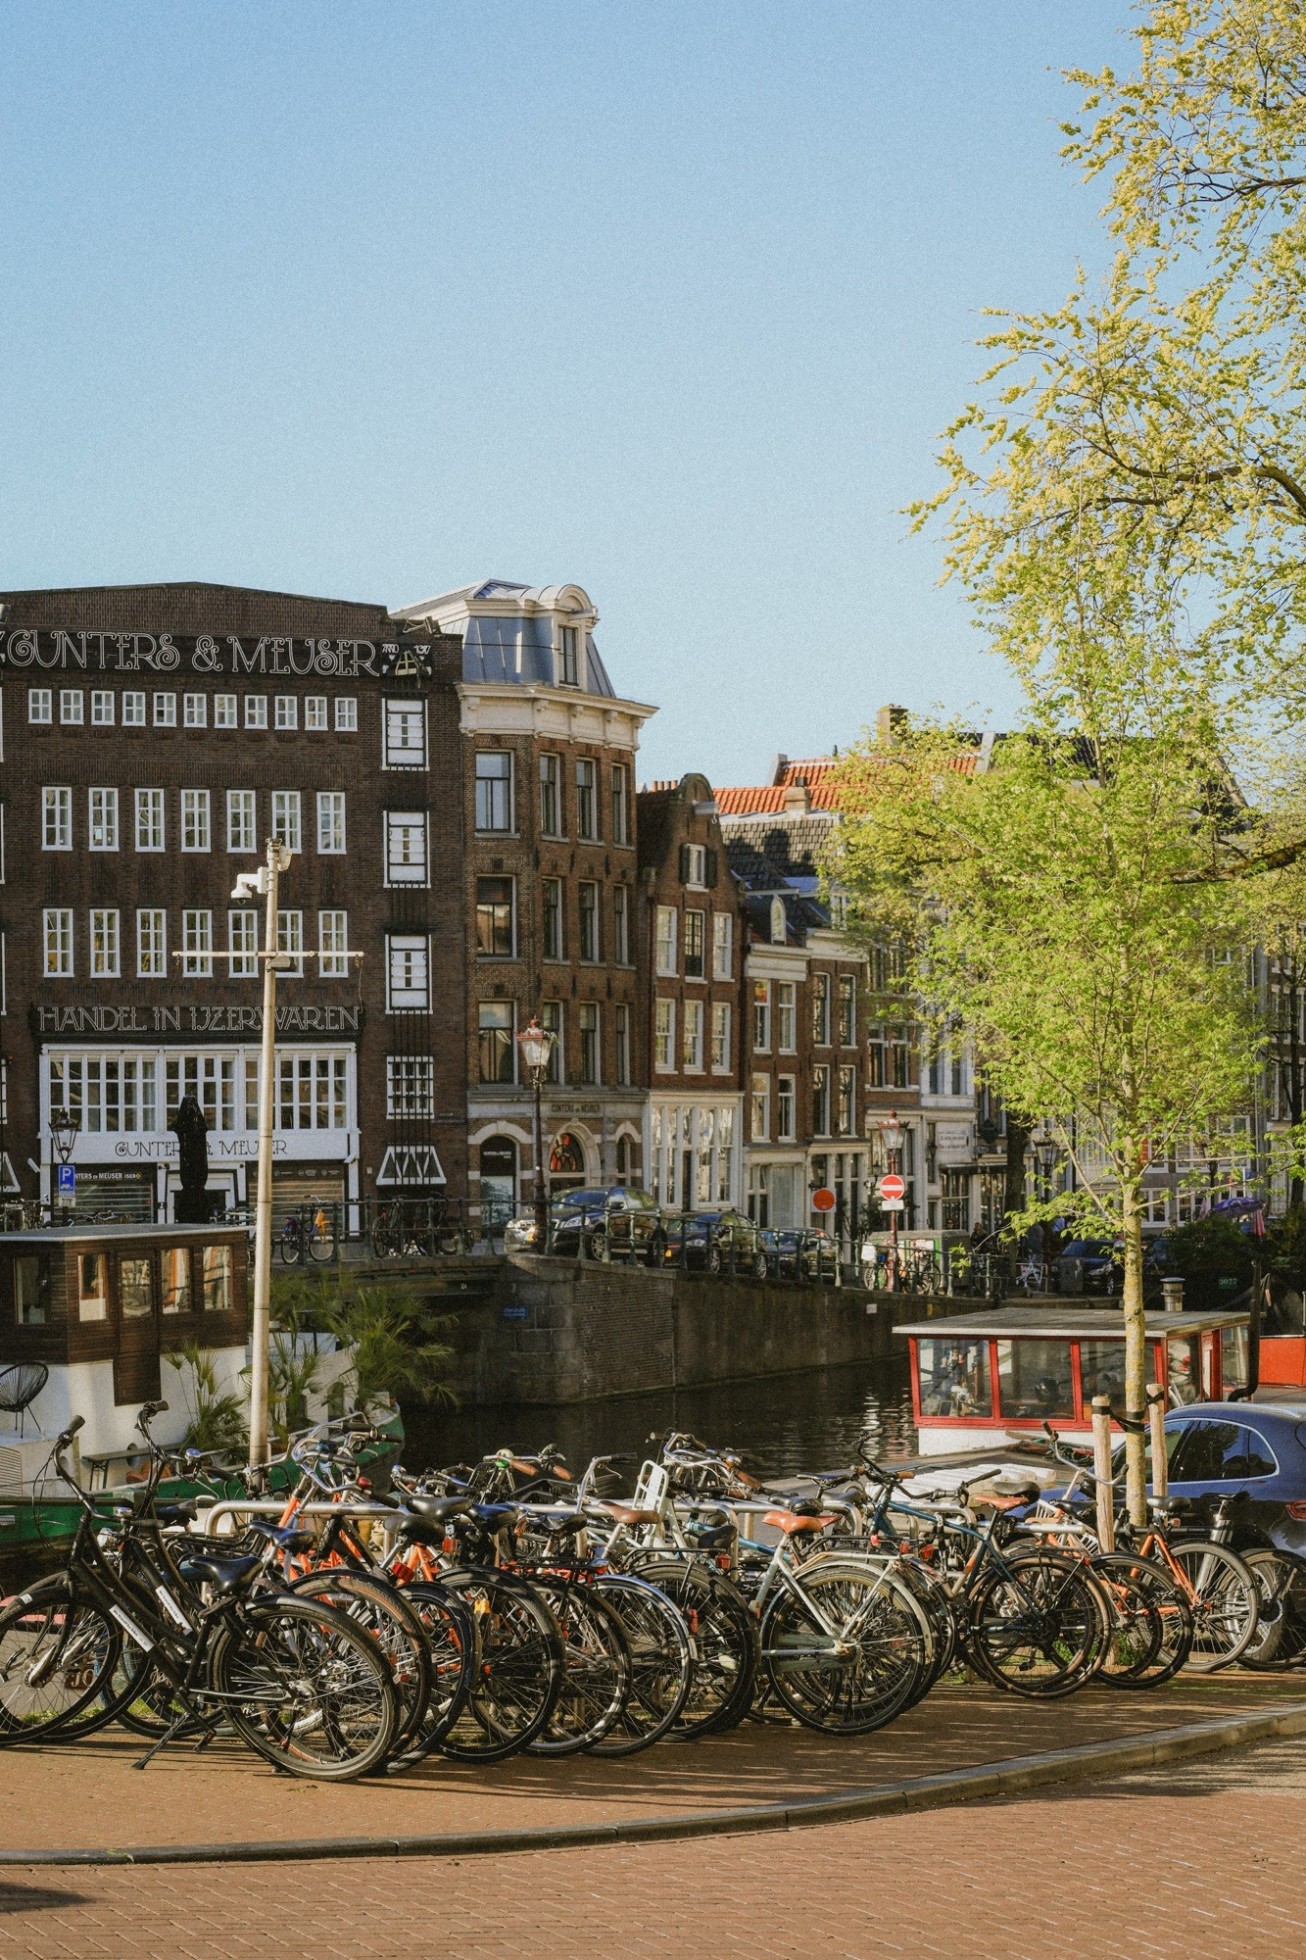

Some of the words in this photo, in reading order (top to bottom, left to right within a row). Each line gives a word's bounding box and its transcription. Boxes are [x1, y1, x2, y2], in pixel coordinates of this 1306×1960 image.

[7, 629, 181, 671] GUNTERS
[191, 634, 224, 672] &
[226, 636, 380, 677] MEUSER
[37, 1006, 147, 1031] HANDEL
[152, 1006, 181, 1030] IN
[189, 1006, 360, 1030] IJZERWAREN
[115, 1141, 180, 1157] GUNTER
[218, 1140, 288, 1156] MEUER
[62, 1167, 72, 1182] P
